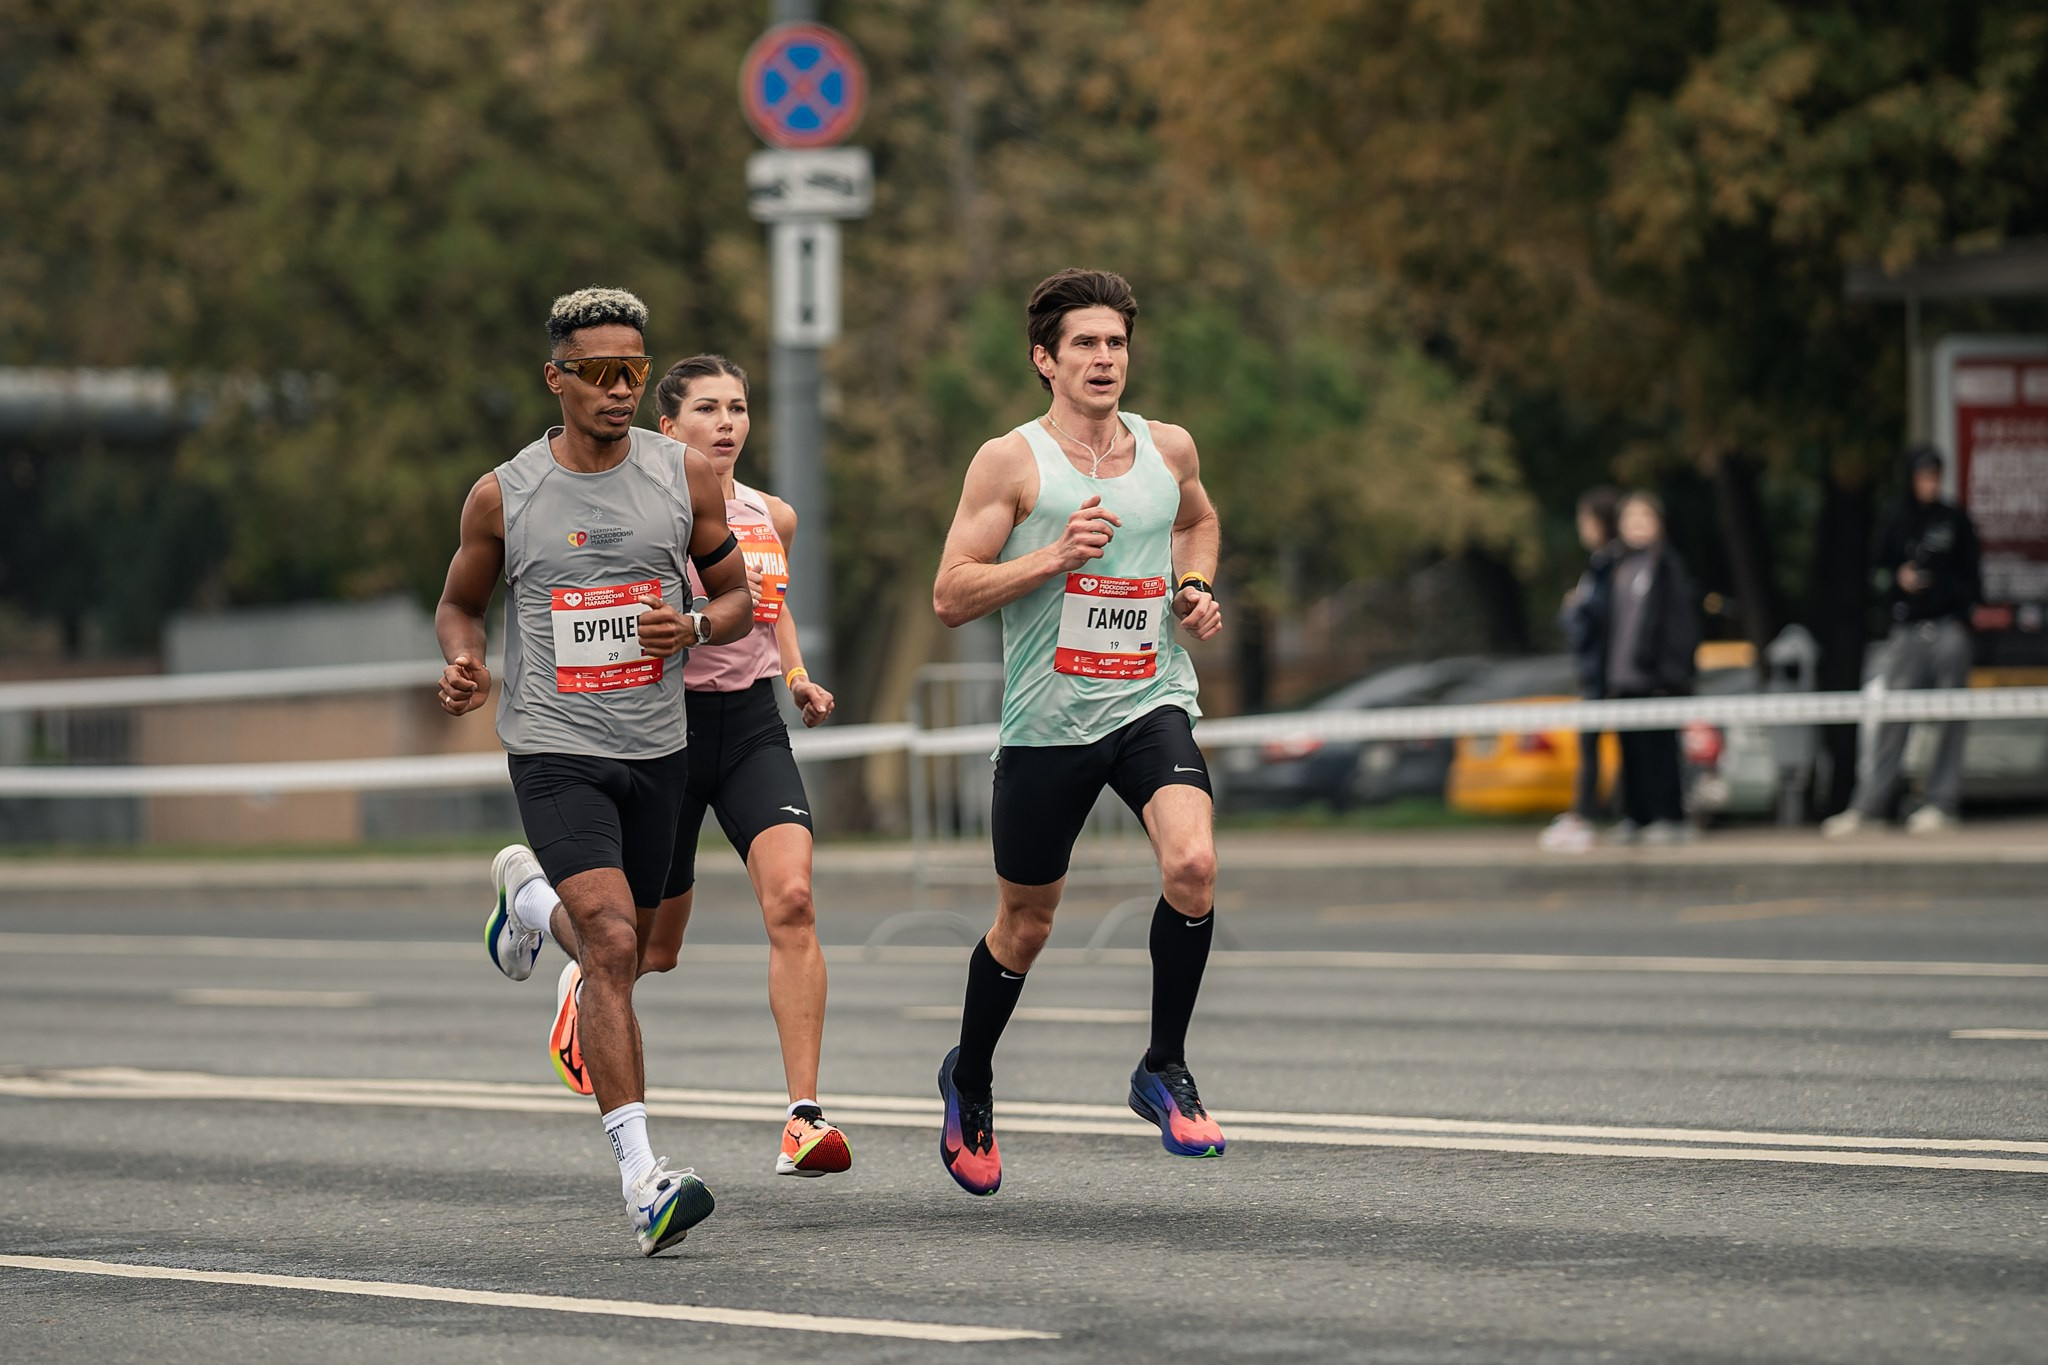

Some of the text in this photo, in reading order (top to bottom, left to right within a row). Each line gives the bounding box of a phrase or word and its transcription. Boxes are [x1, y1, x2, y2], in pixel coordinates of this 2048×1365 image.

[590, 530, 634, 540] МОСКОВСКИЙ
[591, 537, 623, 546] МАРАФОН
[1099, 584, 1139, 592] МОСКОВСКИЙ
[584, 592, 625, 602] МОСКОВСКИЙ
[584, 599, 615, 607] МАРАФОН
[1087, 607, 1147, 630] ГАМОВ
[608, 652, 619, 661] 29
